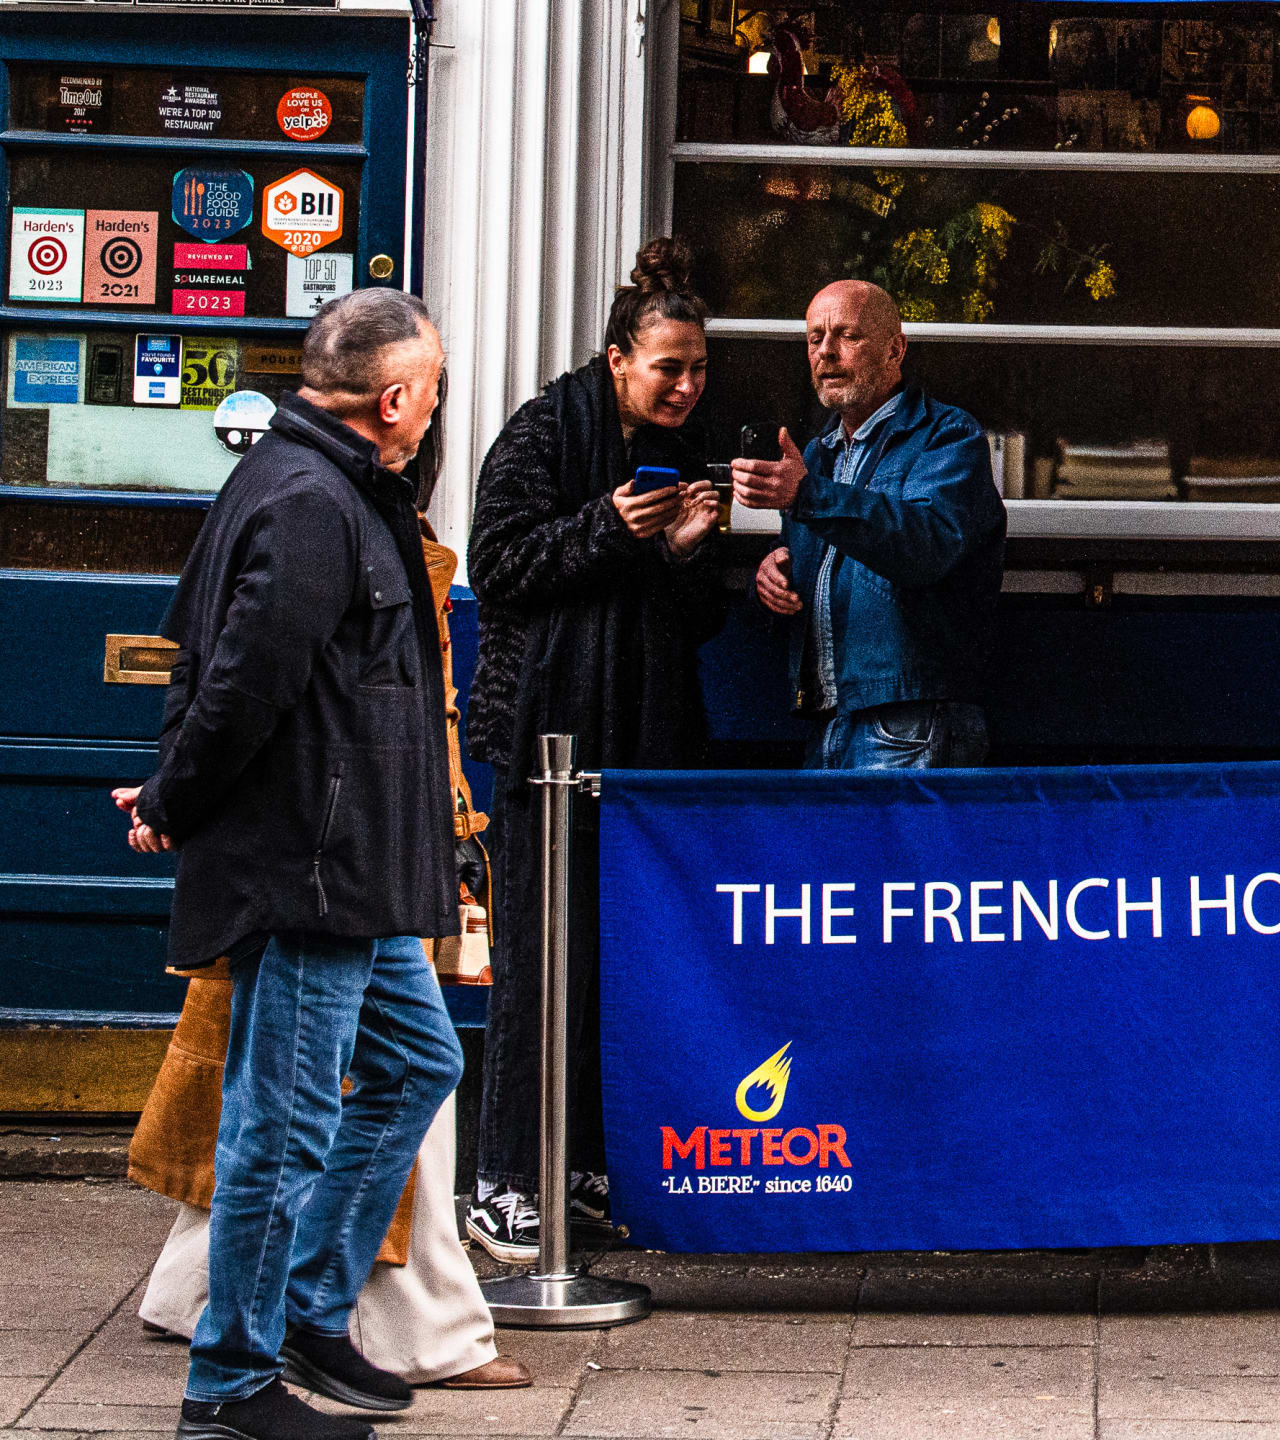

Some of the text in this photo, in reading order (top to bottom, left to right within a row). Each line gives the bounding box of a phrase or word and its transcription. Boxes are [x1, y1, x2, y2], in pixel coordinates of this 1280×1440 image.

[184, 91, 218, 99] RESTAURANT
[184, 97, 206, 105] AWARDS
[287, 99, 323, 107] LOVE US
[73, 108, 86, 116] 2017
[158, 107, 222, 119] WE'RE A TOP 100
[164, 119, 214, 130] RESTAURANT
[283, 113, 314, 131] yelp
[207, 182, 229, 192] THE
[207, 191, 242, 201] GOOD
[206, 200, 239, 209] FOOD
[301, 192, 334, 216] BII
[206, 208, 240, 218] GUIDE
[23, 220, 75, 233] Harden's
[95, 219, 150, 233] Harden's
[192, 218, 232, 229] 2023
[283, 232, 322, 246] 2020
[304, 259, 337, 281] TOP 50
[29, 279, 63, 291] 2023
[174, 274, 245, 285] SQUAREMEAL
[100, 283, 139, 297] 2021
[303, 283, 337, 291] GASTROPUBS
[186, 295, 231, 310] 2023
[15, 361, 76, 371] AMERICAN
[181, 350, 237, 388] 50
[28, 374, 79, 384] EXPRESS
[181, 387, 201, 396] BEST
[202, 388, 225, 398] PUBS
[180, 396, 213, 405] LONDON
[716, 883, 858, 947] THE
[882, 876, 1165, 946] FRENCH
[660, 1124, 852, 1170] METEOR
[765, 1177, 811, 1193] since
[815, 1175, 853, 1192] 1640
